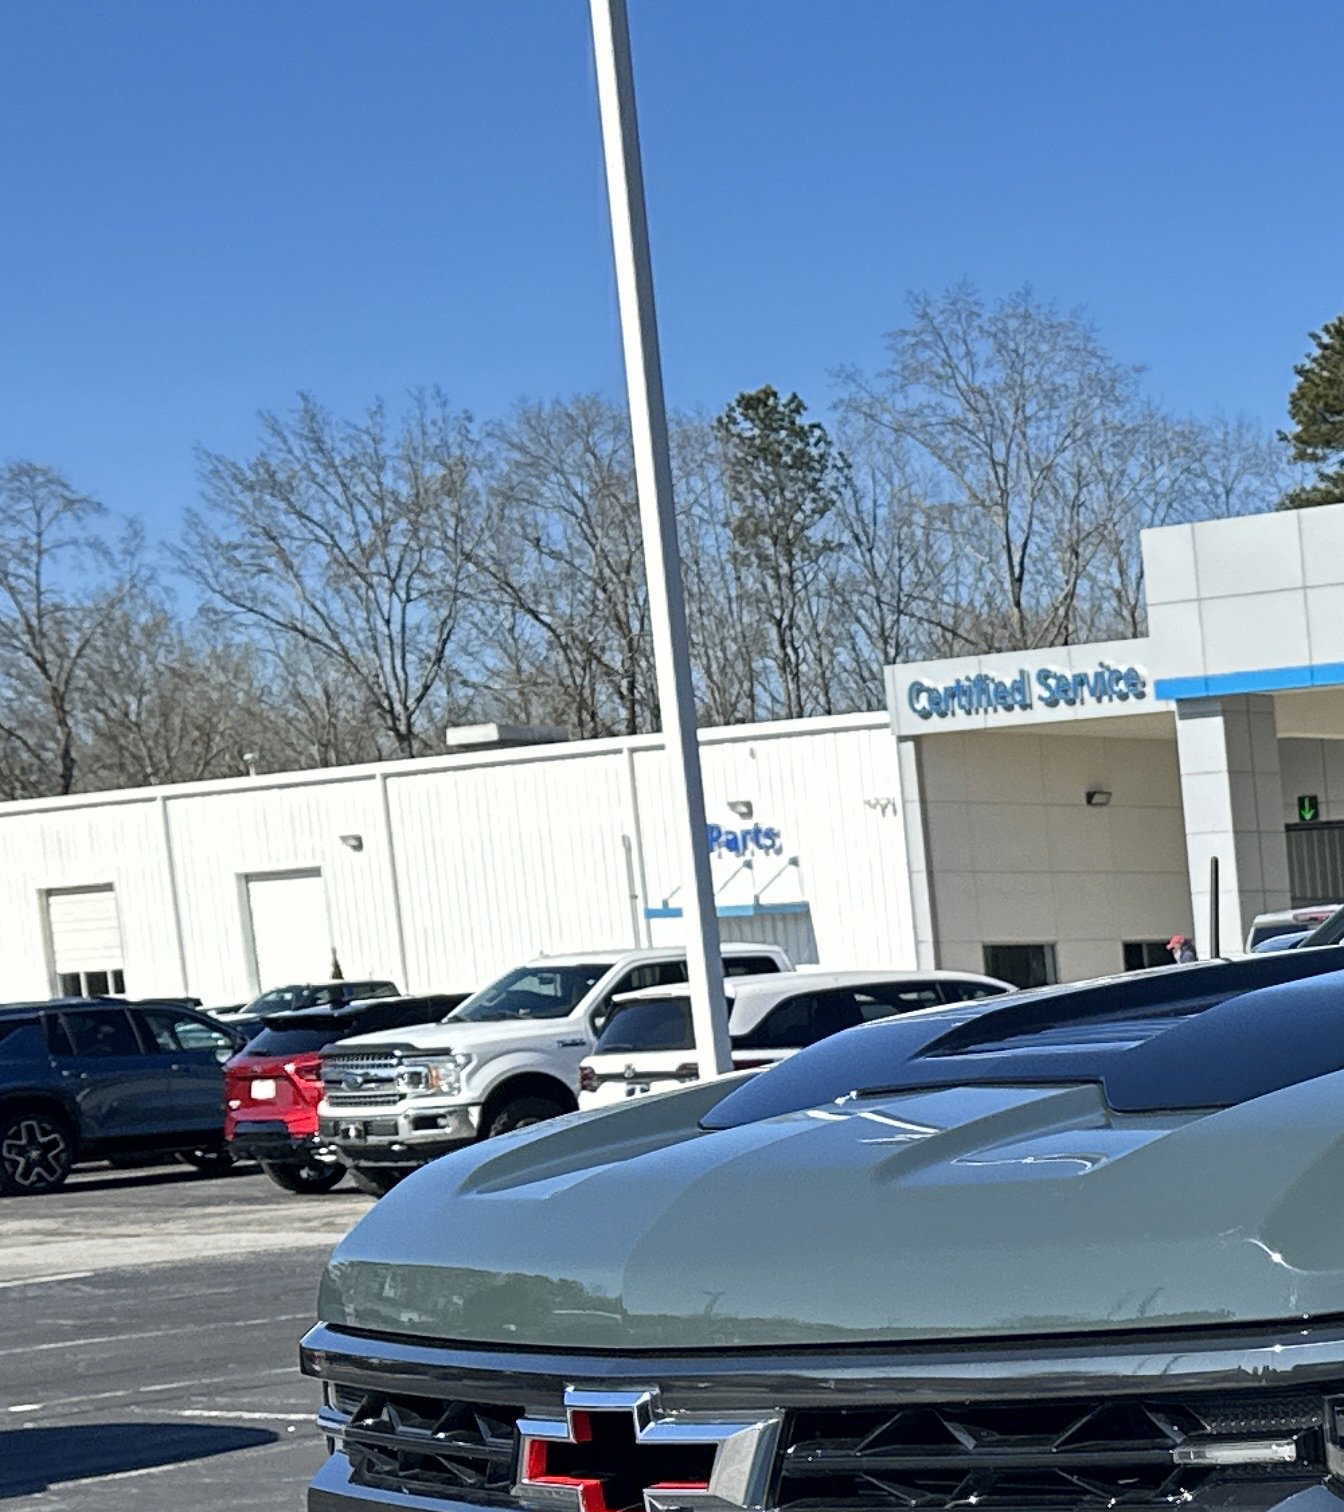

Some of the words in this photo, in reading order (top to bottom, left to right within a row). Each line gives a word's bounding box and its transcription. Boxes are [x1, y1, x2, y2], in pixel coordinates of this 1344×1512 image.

[908, 669, 1032, 719] Certified
[1036, 662, 1145, 707] Service
[706, 823, 777, 852] Parts
